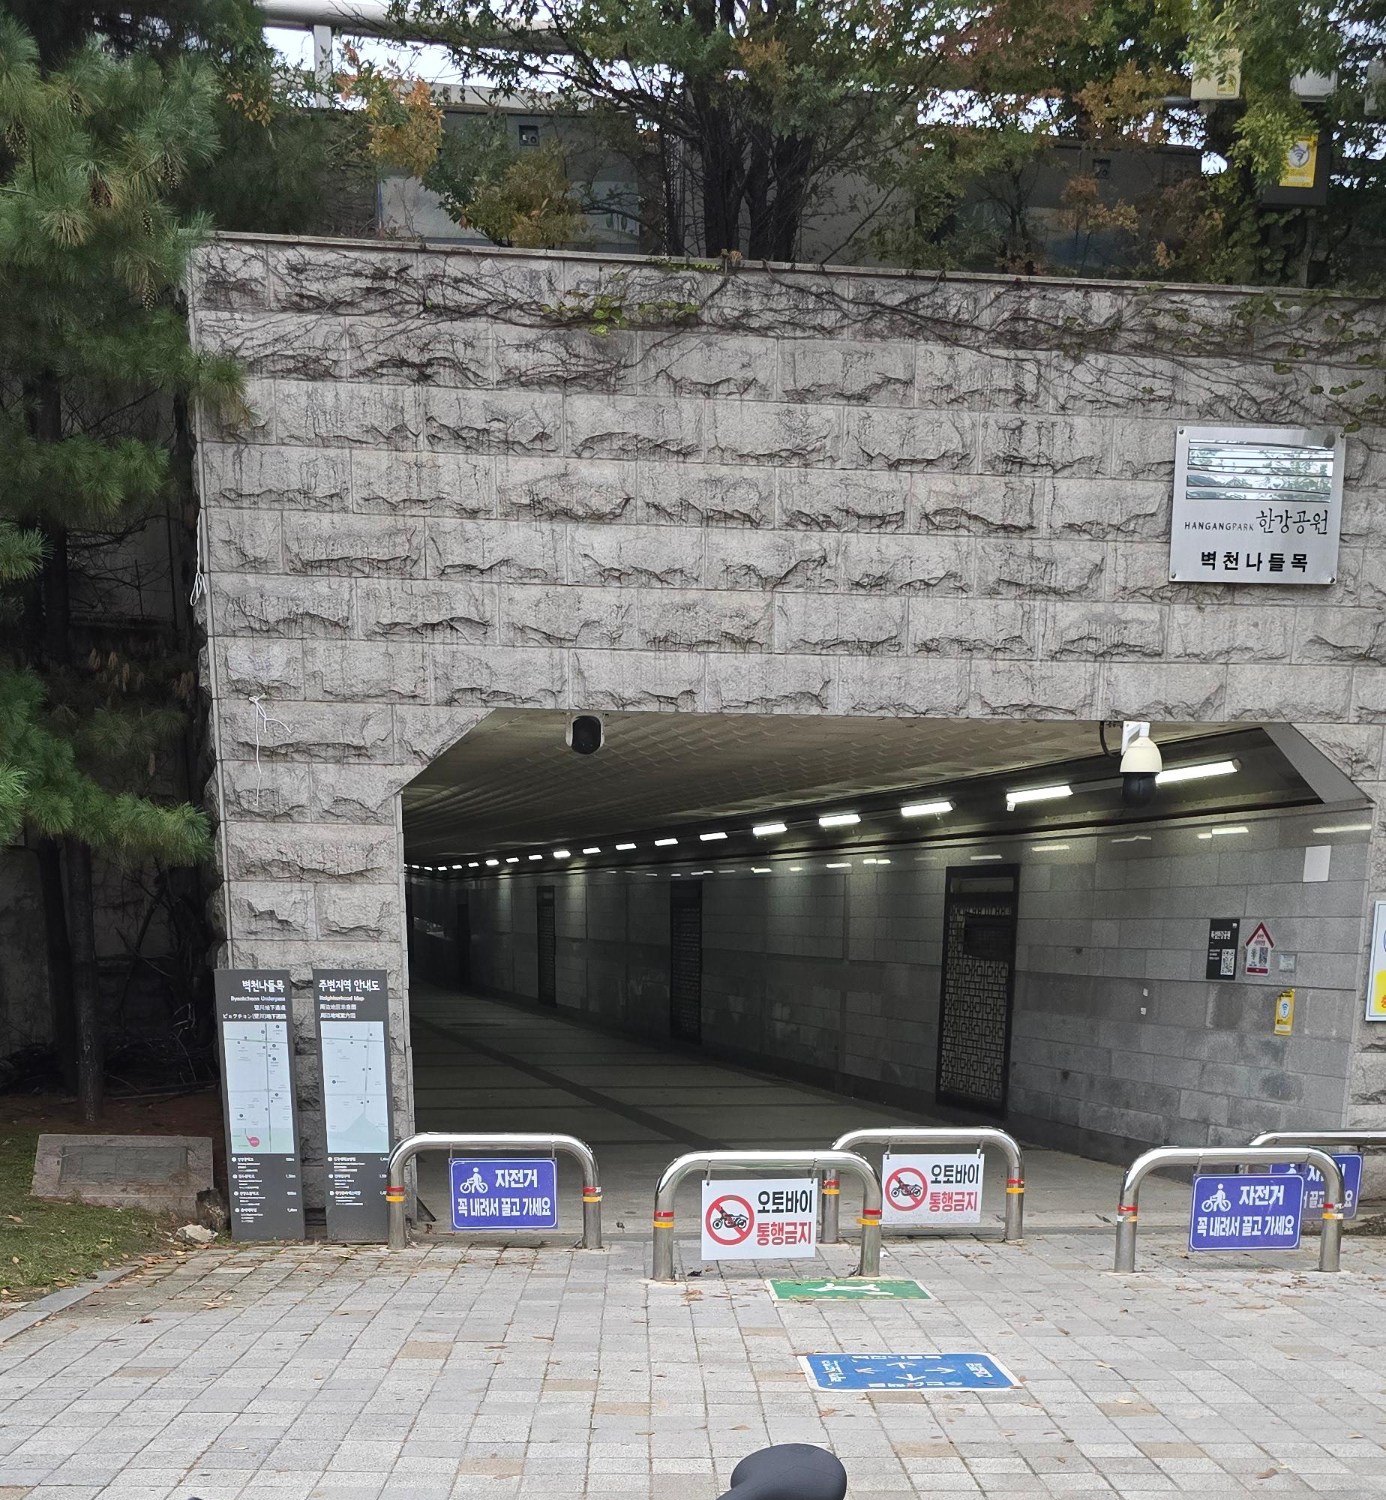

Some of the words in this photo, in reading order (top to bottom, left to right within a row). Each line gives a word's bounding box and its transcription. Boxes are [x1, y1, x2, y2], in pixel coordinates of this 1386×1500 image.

[1256, 508, 1328, 535] 한강공원
[1201, 551, 1308, 573] 벽천나들목
[242, 979, 285, 993] 벽천나들목
[318, 979, 352, 992] 주변지역
[353, 979, 380, 992] 안내도
[495, 1169, 538, 1188] 자전거
[930, 1164, 980, 1185] 오토바이
[757, 1190, 813, 1214] 오토바이
[929, 1191, 978, 1212] 통행금지
[1239, 1185, 1285, 1206] 자전거
[458, 1198, 468, 1217] 꼭
[470, 1198, 499, 1217] 내려서
[501, 1197, 521, 1217] 끌고
[522, 1196, 551, 1217] 가세요
[756, 1221, 812, 1246] 통행금지
[1197, 1217, 1208, 1237] 꼭
[1209, 1216, 1240, 1237] 내려서
[1241, 1216, 1262, 1236] 끌고
[1264, 1214, 1295, 1236] 가세요
